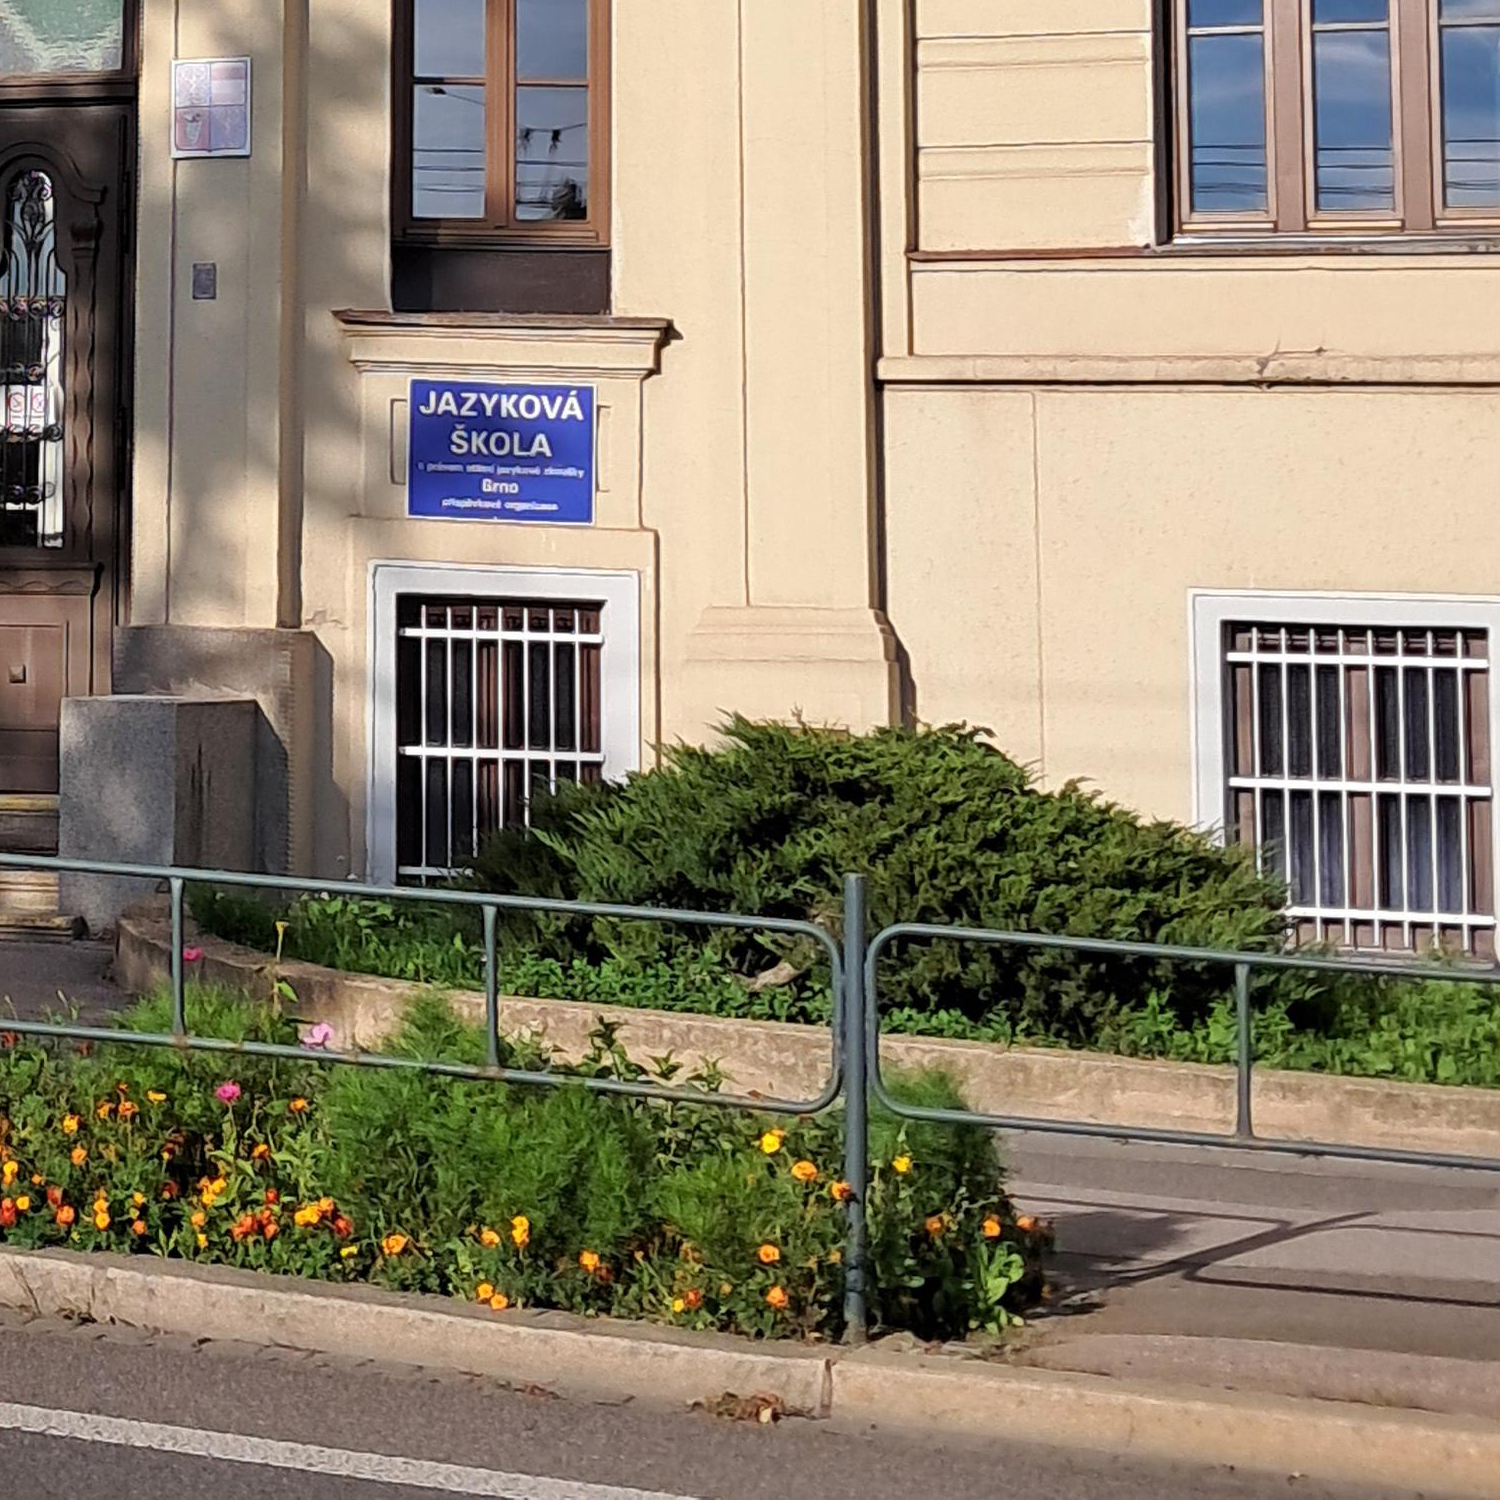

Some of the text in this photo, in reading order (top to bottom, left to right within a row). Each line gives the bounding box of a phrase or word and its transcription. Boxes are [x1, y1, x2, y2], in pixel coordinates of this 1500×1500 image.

[419, 390, 584, 420] JAZYKOVÁ
[450, 424, 552, 457] ŠKOLA
[482, 479, 519, 493] Brno
